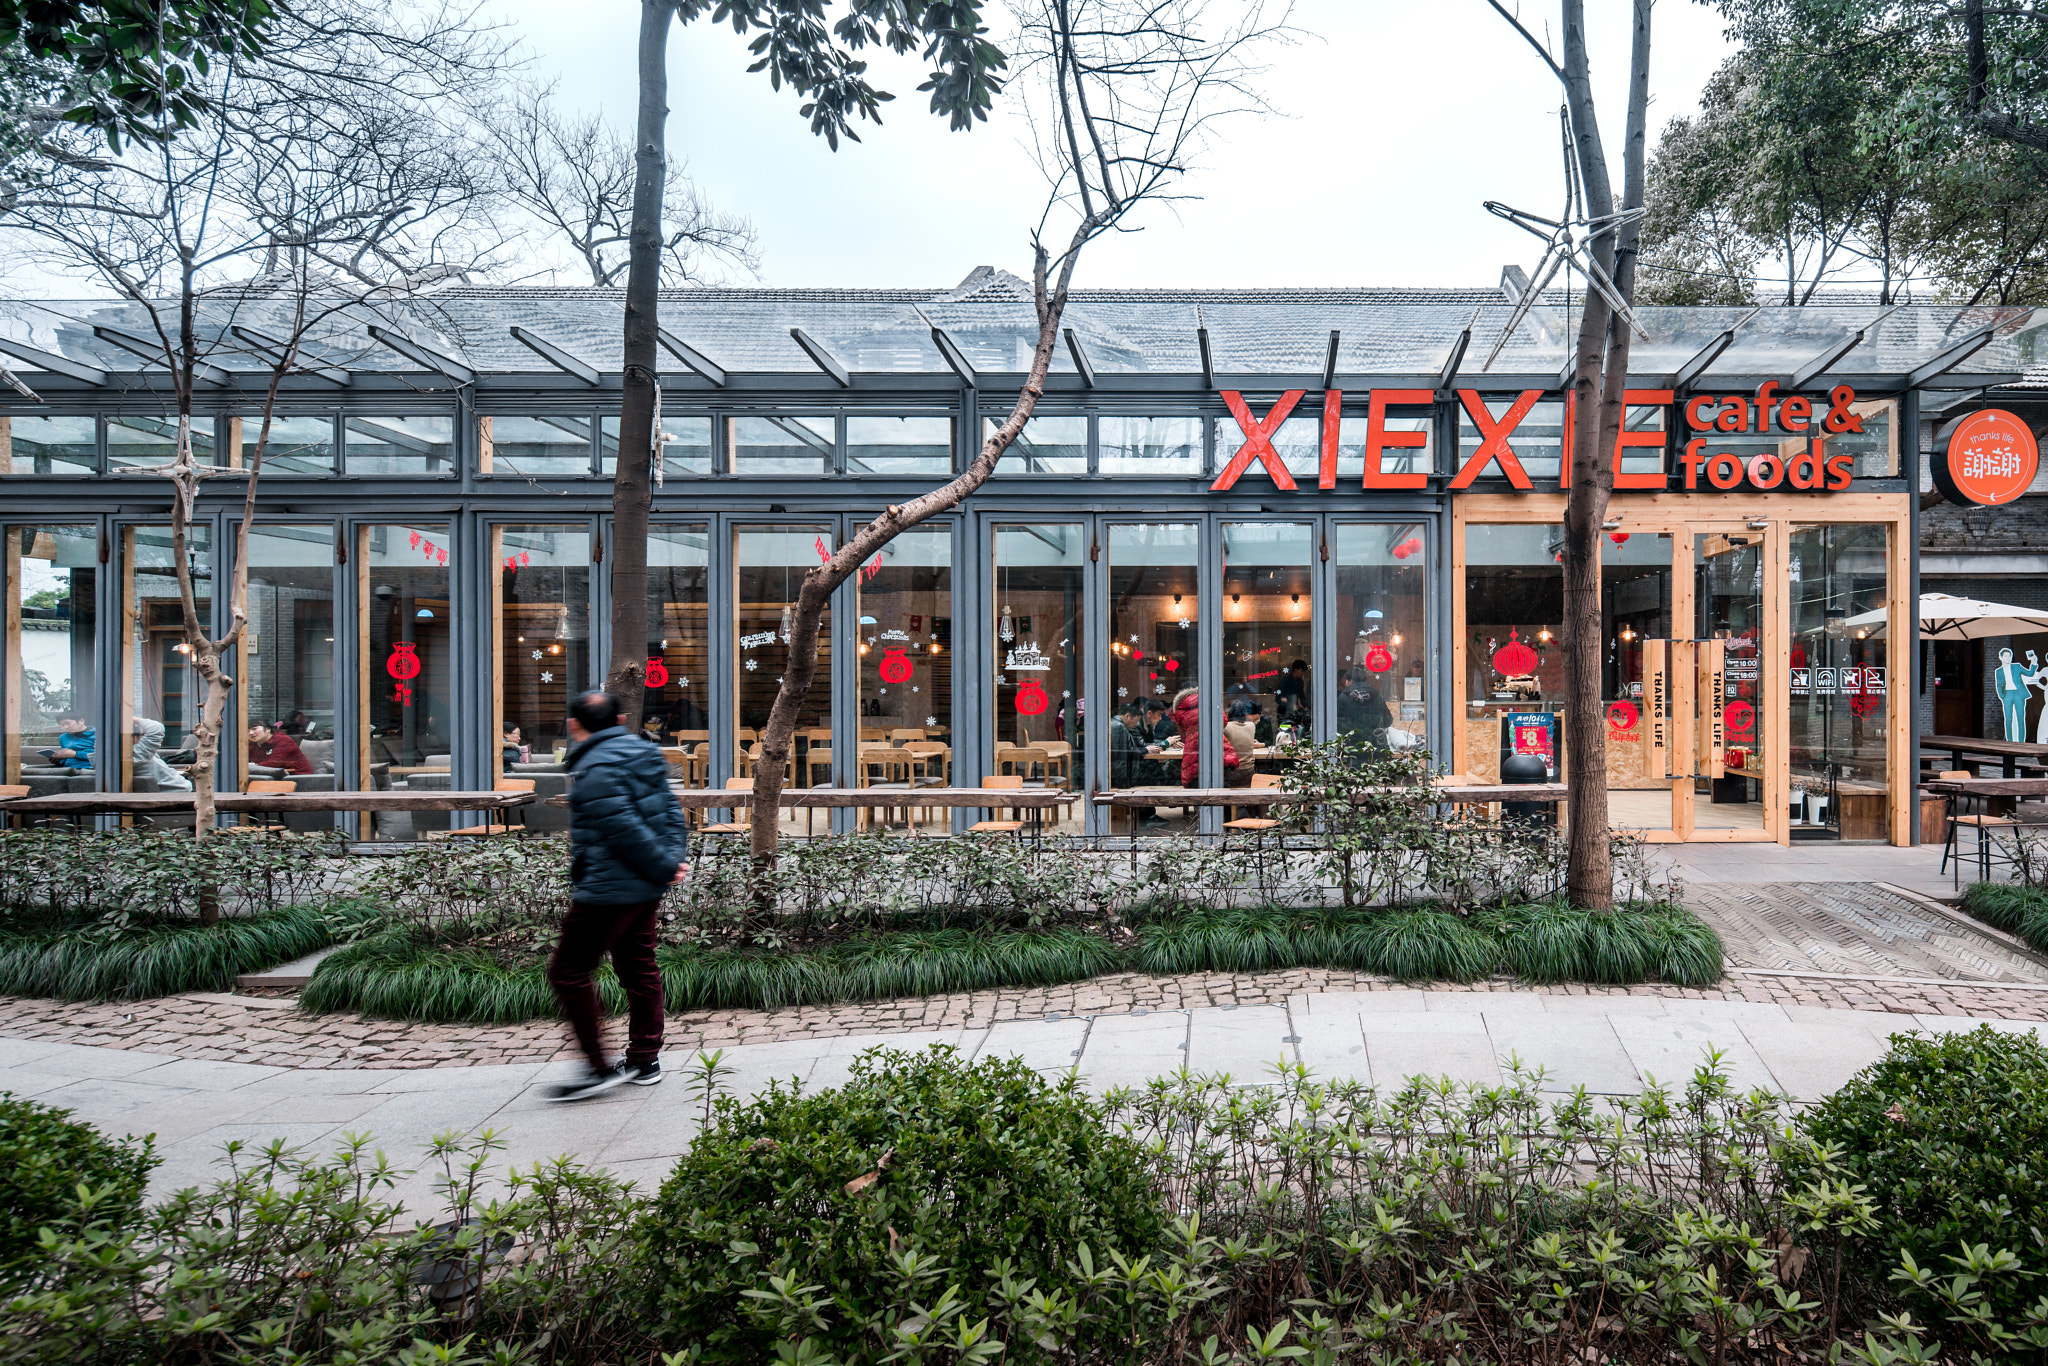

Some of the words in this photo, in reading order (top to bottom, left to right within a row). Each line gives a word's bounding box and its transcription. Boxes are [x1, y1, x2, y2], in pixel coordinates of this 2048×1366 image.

[1685, 380, 1812, 432] cafe
[1825, 384, 1864, 433] &
[1970, 431, 2001, 444] thanks
[2001, 432, 2015, 444] life
[1681, 438, 1854, 491] foods
[1963, 446, 2022, 479] 謝謝
